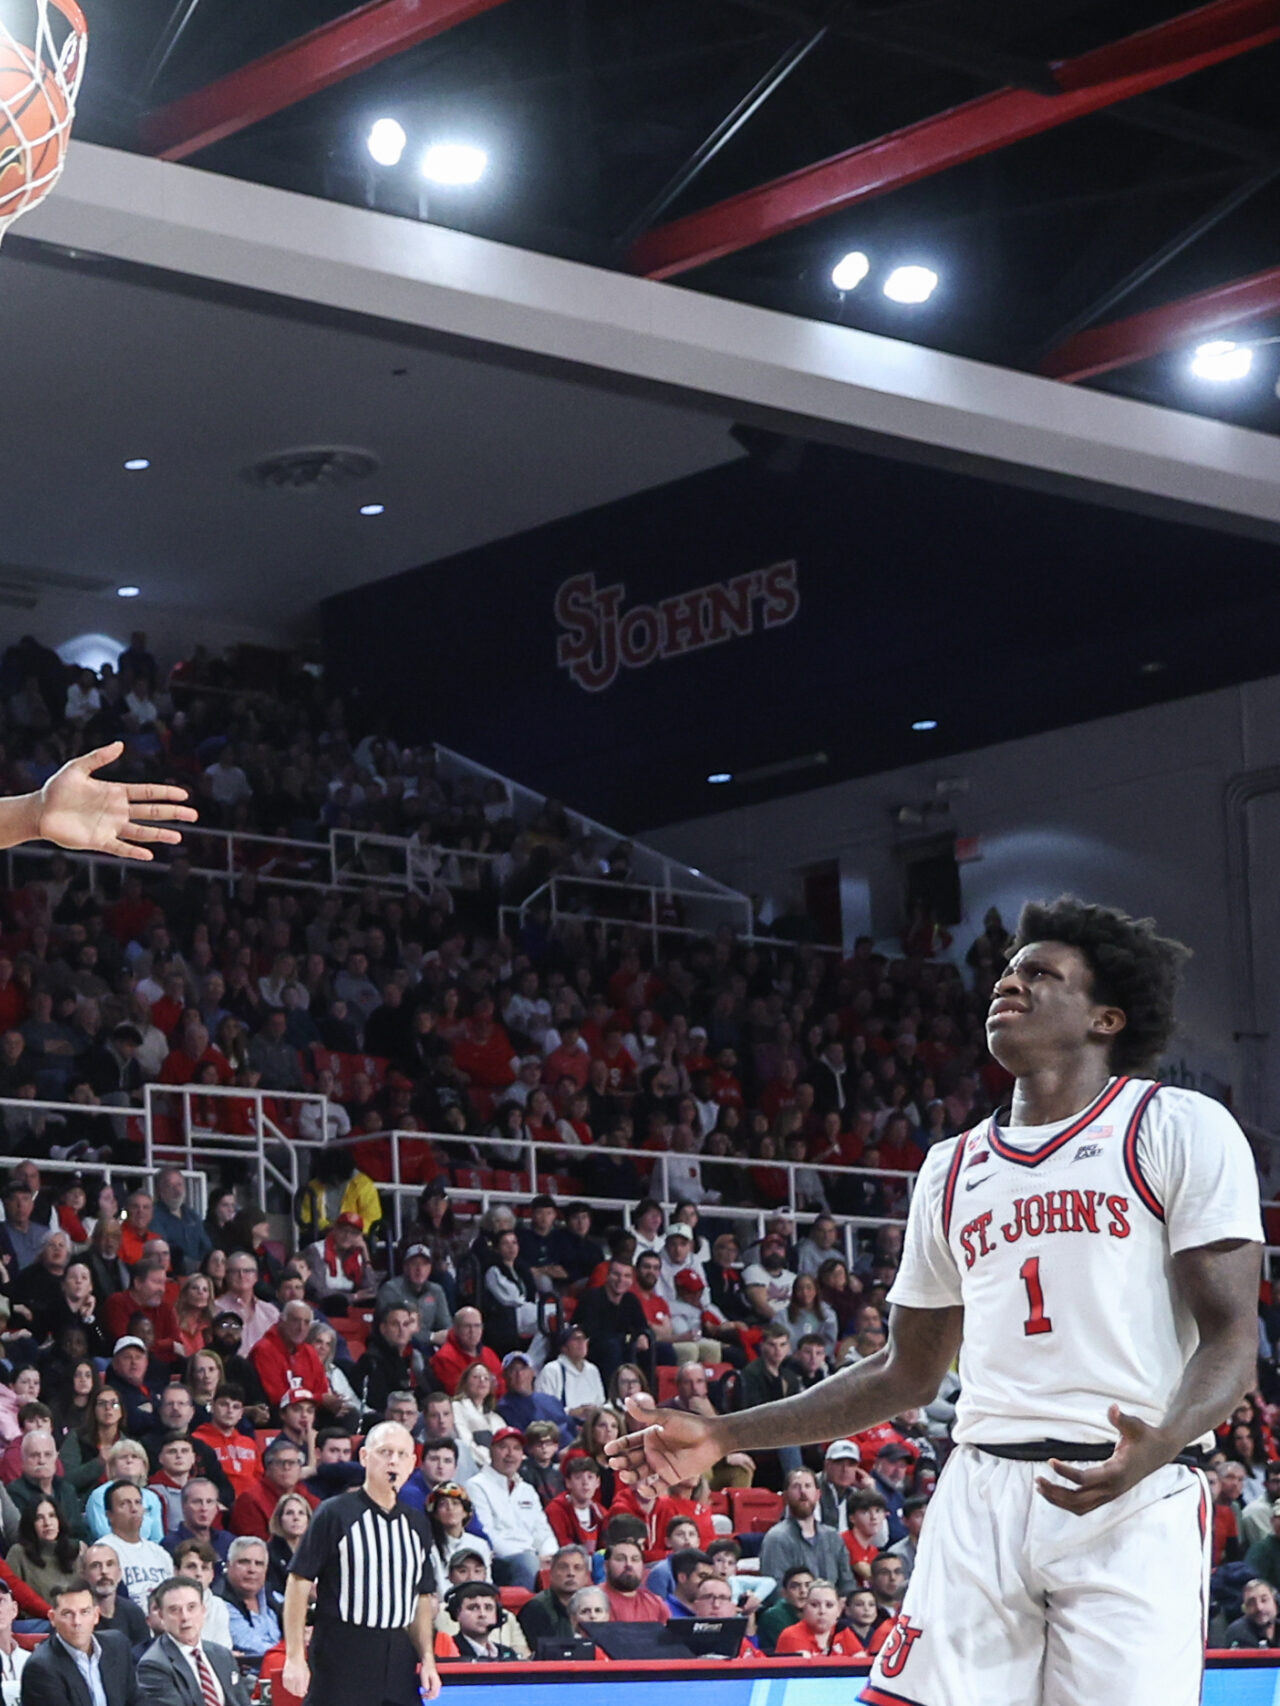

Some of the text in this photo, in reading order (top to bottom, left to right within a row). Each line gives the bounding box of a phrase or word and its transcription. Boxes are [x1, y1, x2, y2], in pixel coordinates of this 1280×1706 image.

[959, 1189, 1132, 1272] ST. JOHN'S
[1019, 1255, 1053, 1337] 1
[124, 1565, 165, 1586] BEAST
